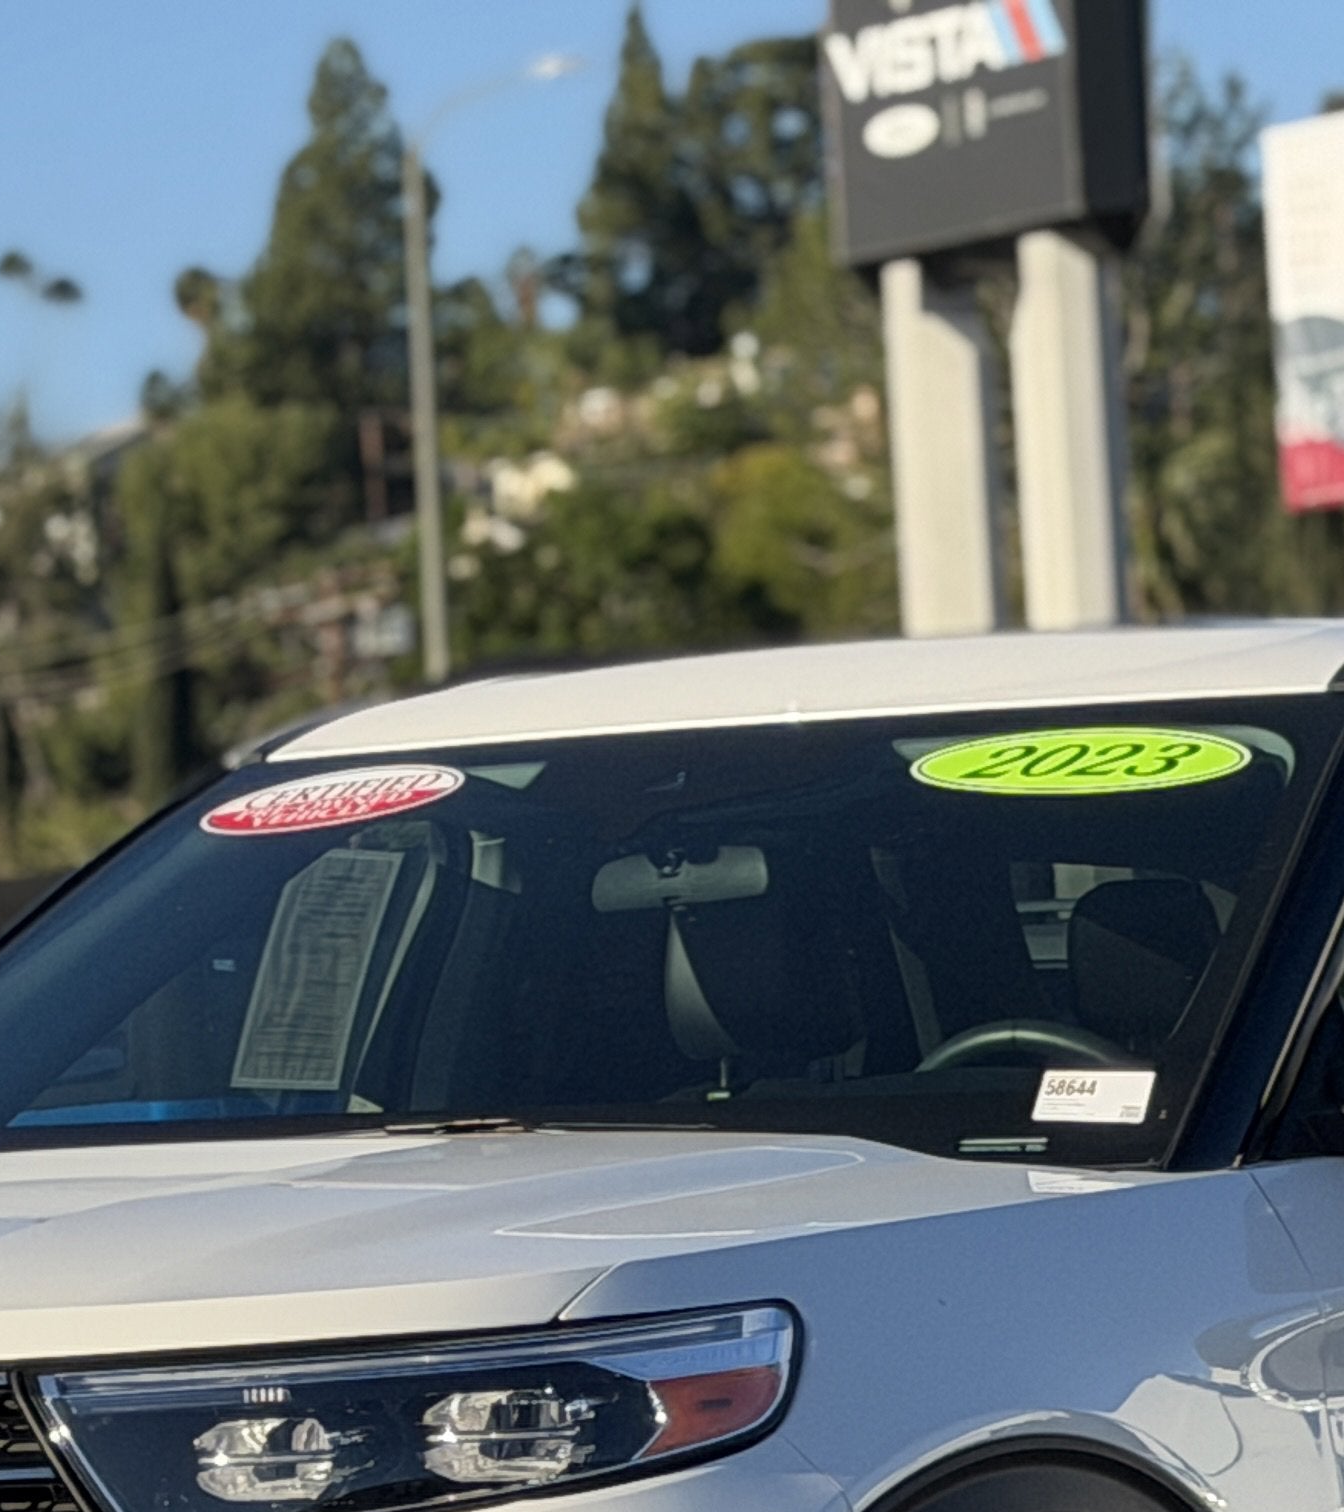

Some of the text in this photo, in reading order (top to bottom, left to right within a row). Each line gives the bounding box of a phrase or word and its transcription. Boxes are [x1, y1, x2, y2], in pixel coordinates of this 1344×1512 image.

[823, 4, 1008, 102] VISTA
[958, 743, 1203, 779] 2023
[245, 773, 442, 810] CERTIFIED
